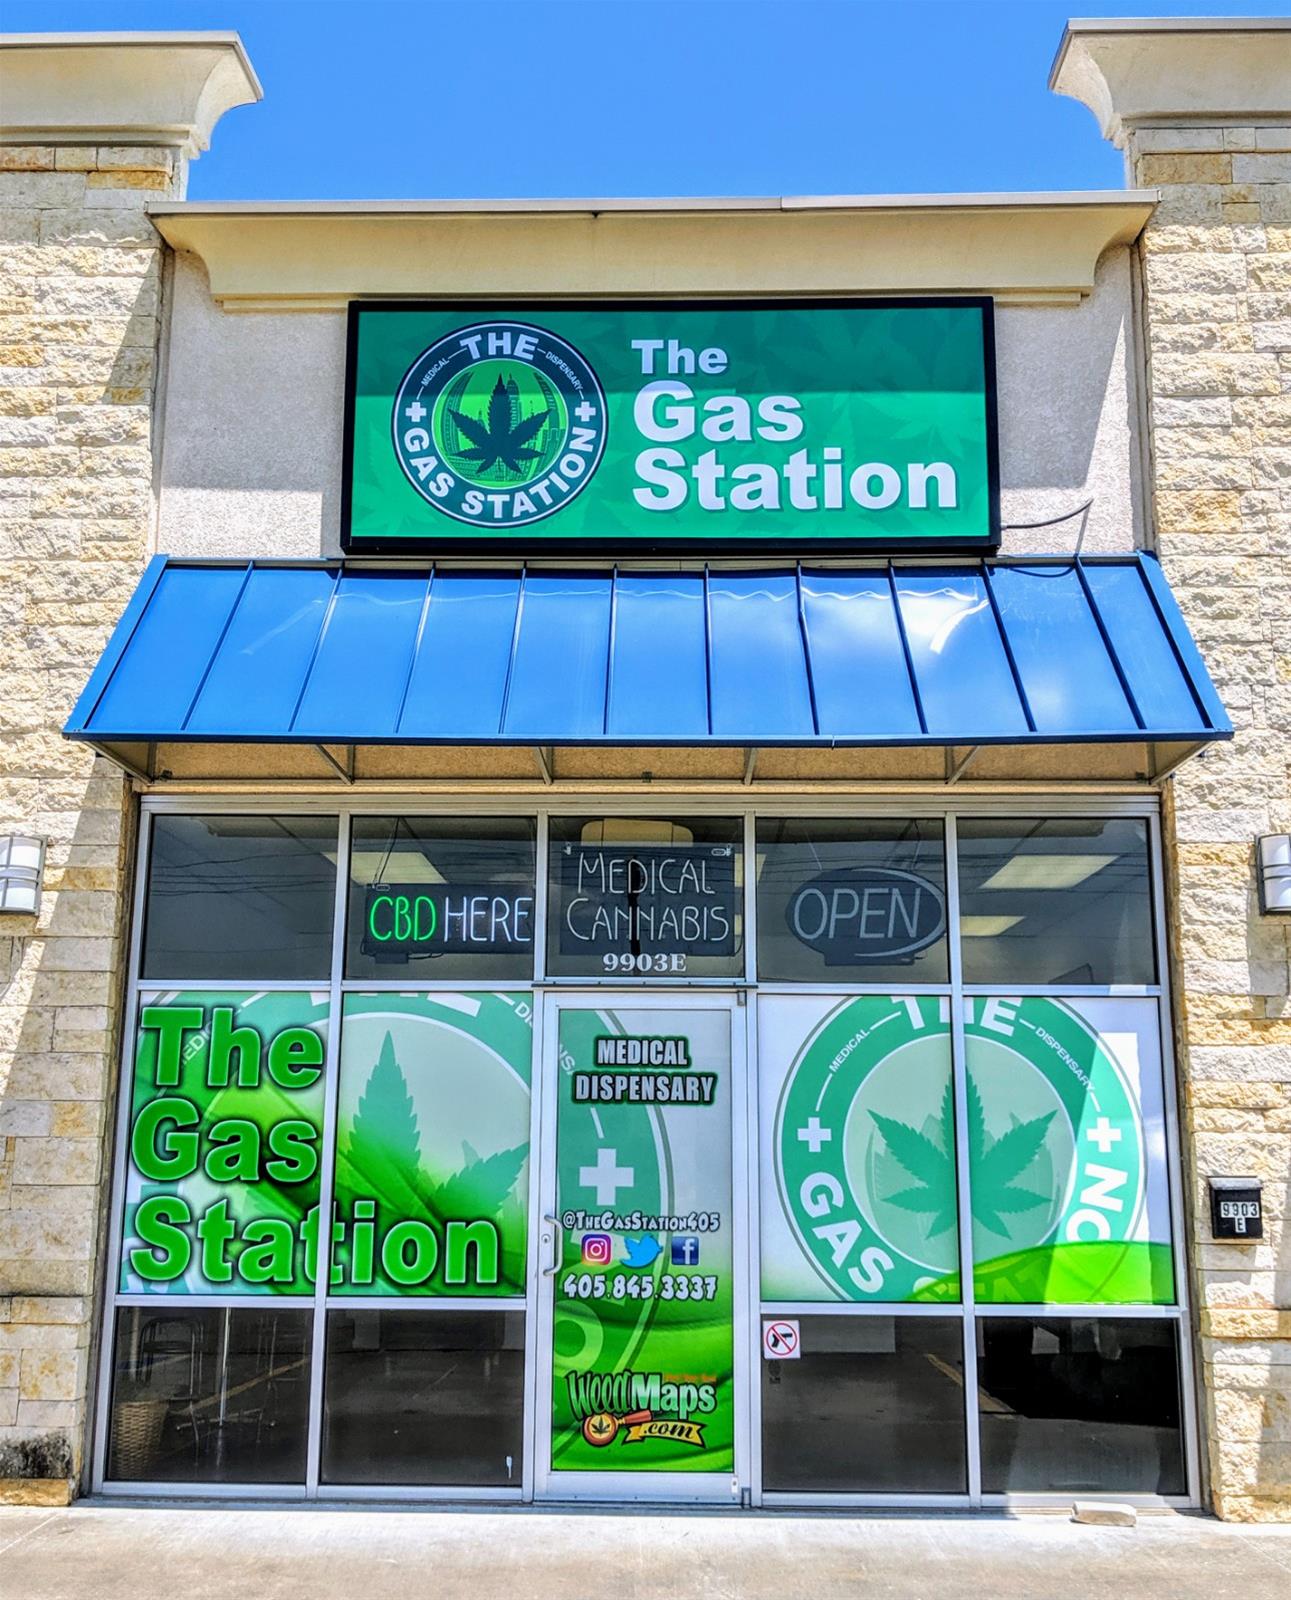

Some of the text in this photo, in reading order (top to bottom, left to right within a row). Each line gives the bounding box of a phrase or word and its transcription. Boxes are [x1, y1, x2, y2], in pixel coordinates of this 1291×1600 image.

[459, 331, 540, 360] THE
[631, 339, 728, 374] The
[421, 357, 449, 386] MEDICAL
[545, 351, 584, 391] DISPENSARY
[633, 380, 804, 442] Gas
[404, 426, 597, 518] GAS STATION
[632, 446, 958, 511] Station
[578, 852, 715, 894] MEDICAL
[369, 896, 532, 942] CBD HERE
[567, 898, 729, 940] CANNABIS
[794, 887, 921, 939] OPEN
[603, 953, 687, 972] 9903E
[140, 1006, 324, 1089] The
[597, 1039, 688, 1066] MEDICAL
[829, 1029, 870, 1072] MEDICAL
[1035, 1027, 1095, 1091] DISPENSARY
[575, 1075, 714, 1102] DISPENSARY
[132, 1097, 318, 1184] Gas
[1223, 1203, 1258, 1217] 9903
[1237, 1217, 1244, 1231] E
[129, 1195, 499, 1285] Station
[800, 1171, 895, 1293] GAS
[563, 1273, 717, 1300] 405.845.3337
[567, 1371, 716, 1420] WeedMaps
[643, 1421, 694, 1440] .com
